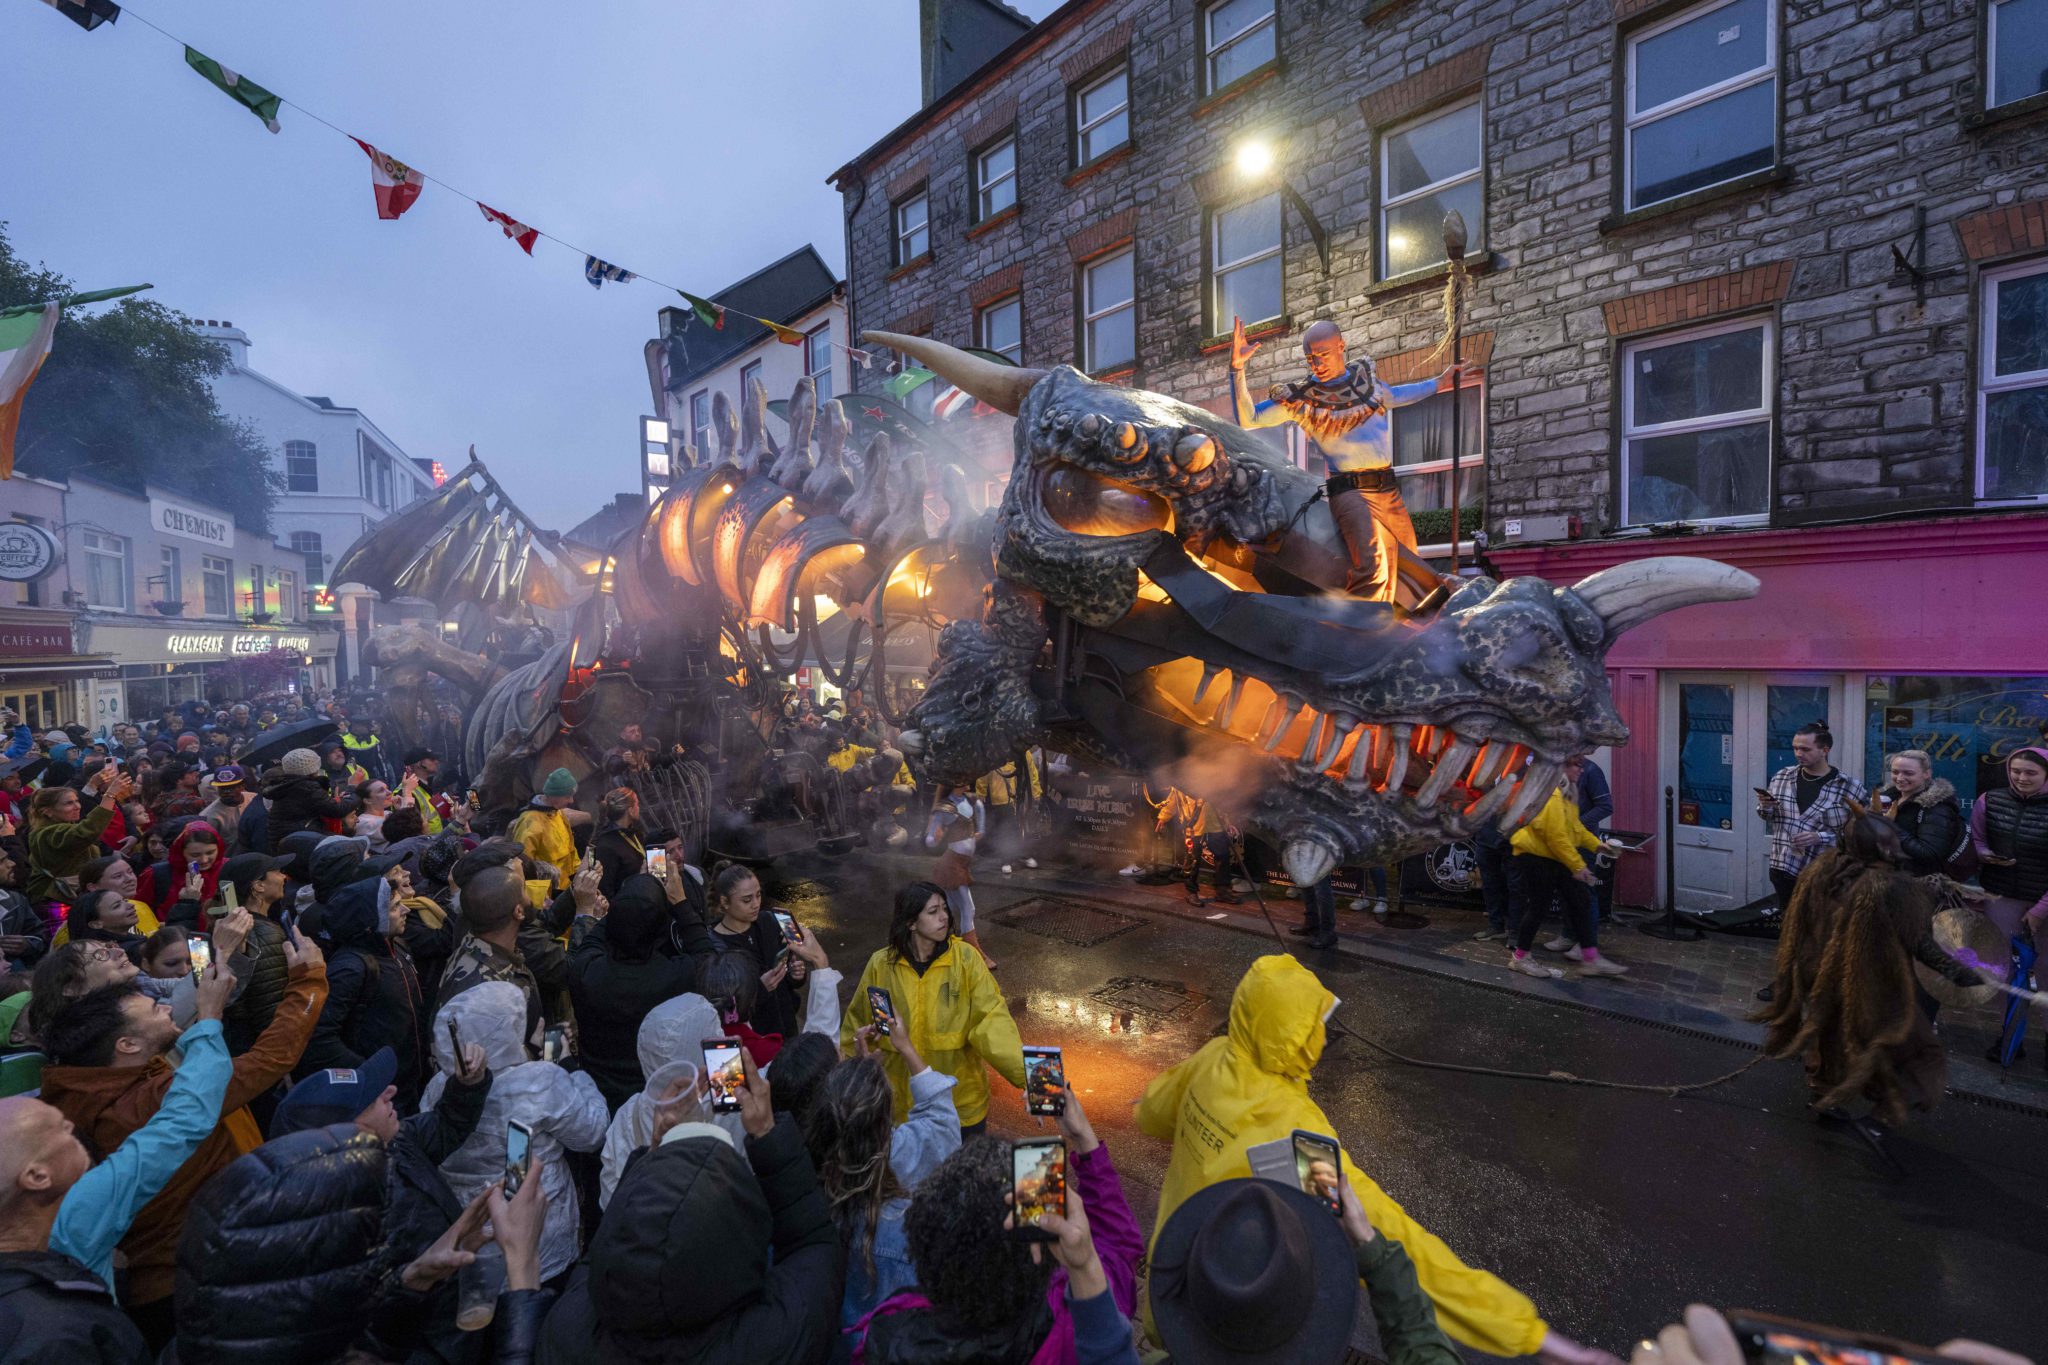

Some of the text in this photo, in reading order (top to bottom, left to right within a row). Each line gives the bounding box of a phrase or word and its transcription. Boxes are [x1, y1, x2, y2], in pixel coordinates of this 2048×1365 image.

[163, 508, 226, 541] CHEMIST
[2, 633, 64, 646] CAFÉ BAR
[168, 635, 225, 653] FLANAGANS
[1086, 784, 1113, 798] LIVE
[1066, 798, 1135, 817] IRISH MUSIC
[1266, 870, 1278, 878] THE
[1330, 880, 1357, 890] GALWAY
